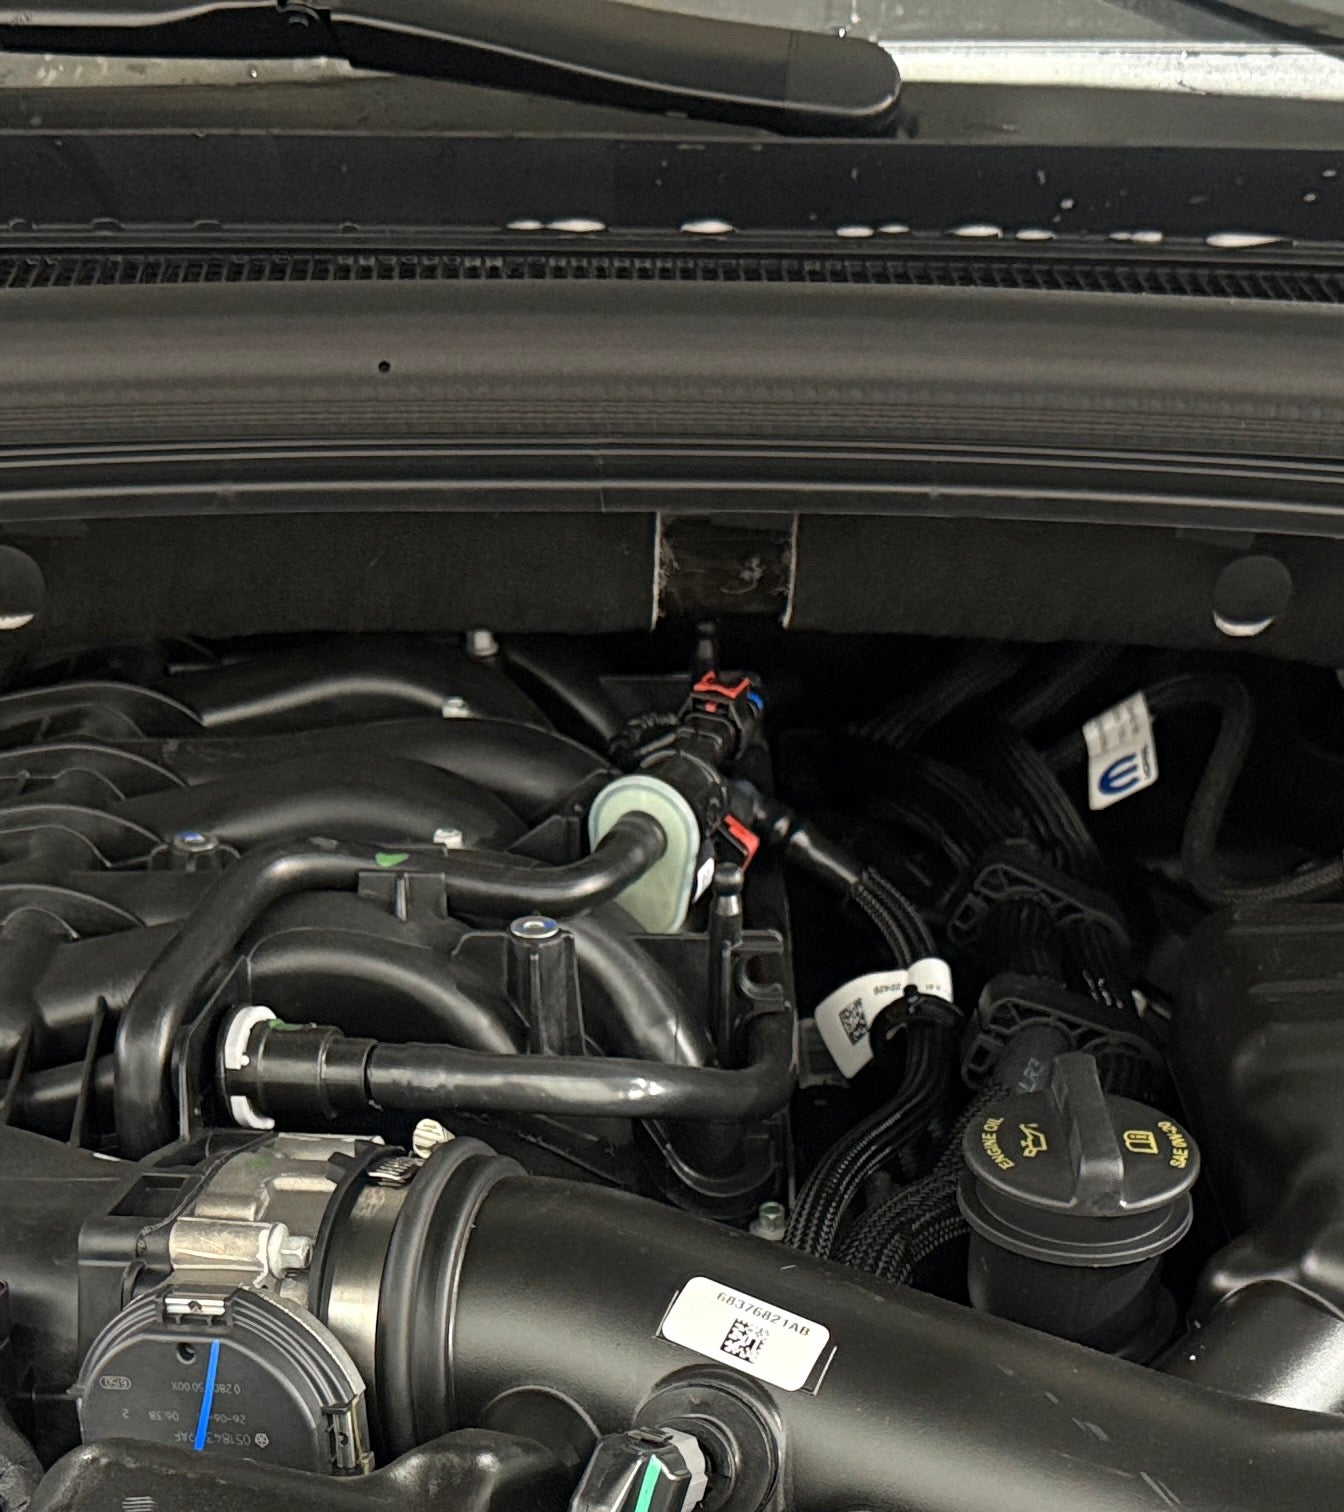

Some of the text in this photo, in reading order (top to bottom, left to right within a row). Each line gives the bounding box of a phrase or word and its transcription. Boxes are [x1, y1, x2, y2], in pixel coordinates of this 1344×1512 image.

[981, 1117, 1015, 1170] ENGINE OIL
[1169, 1148, 1189, 1169] SAE
